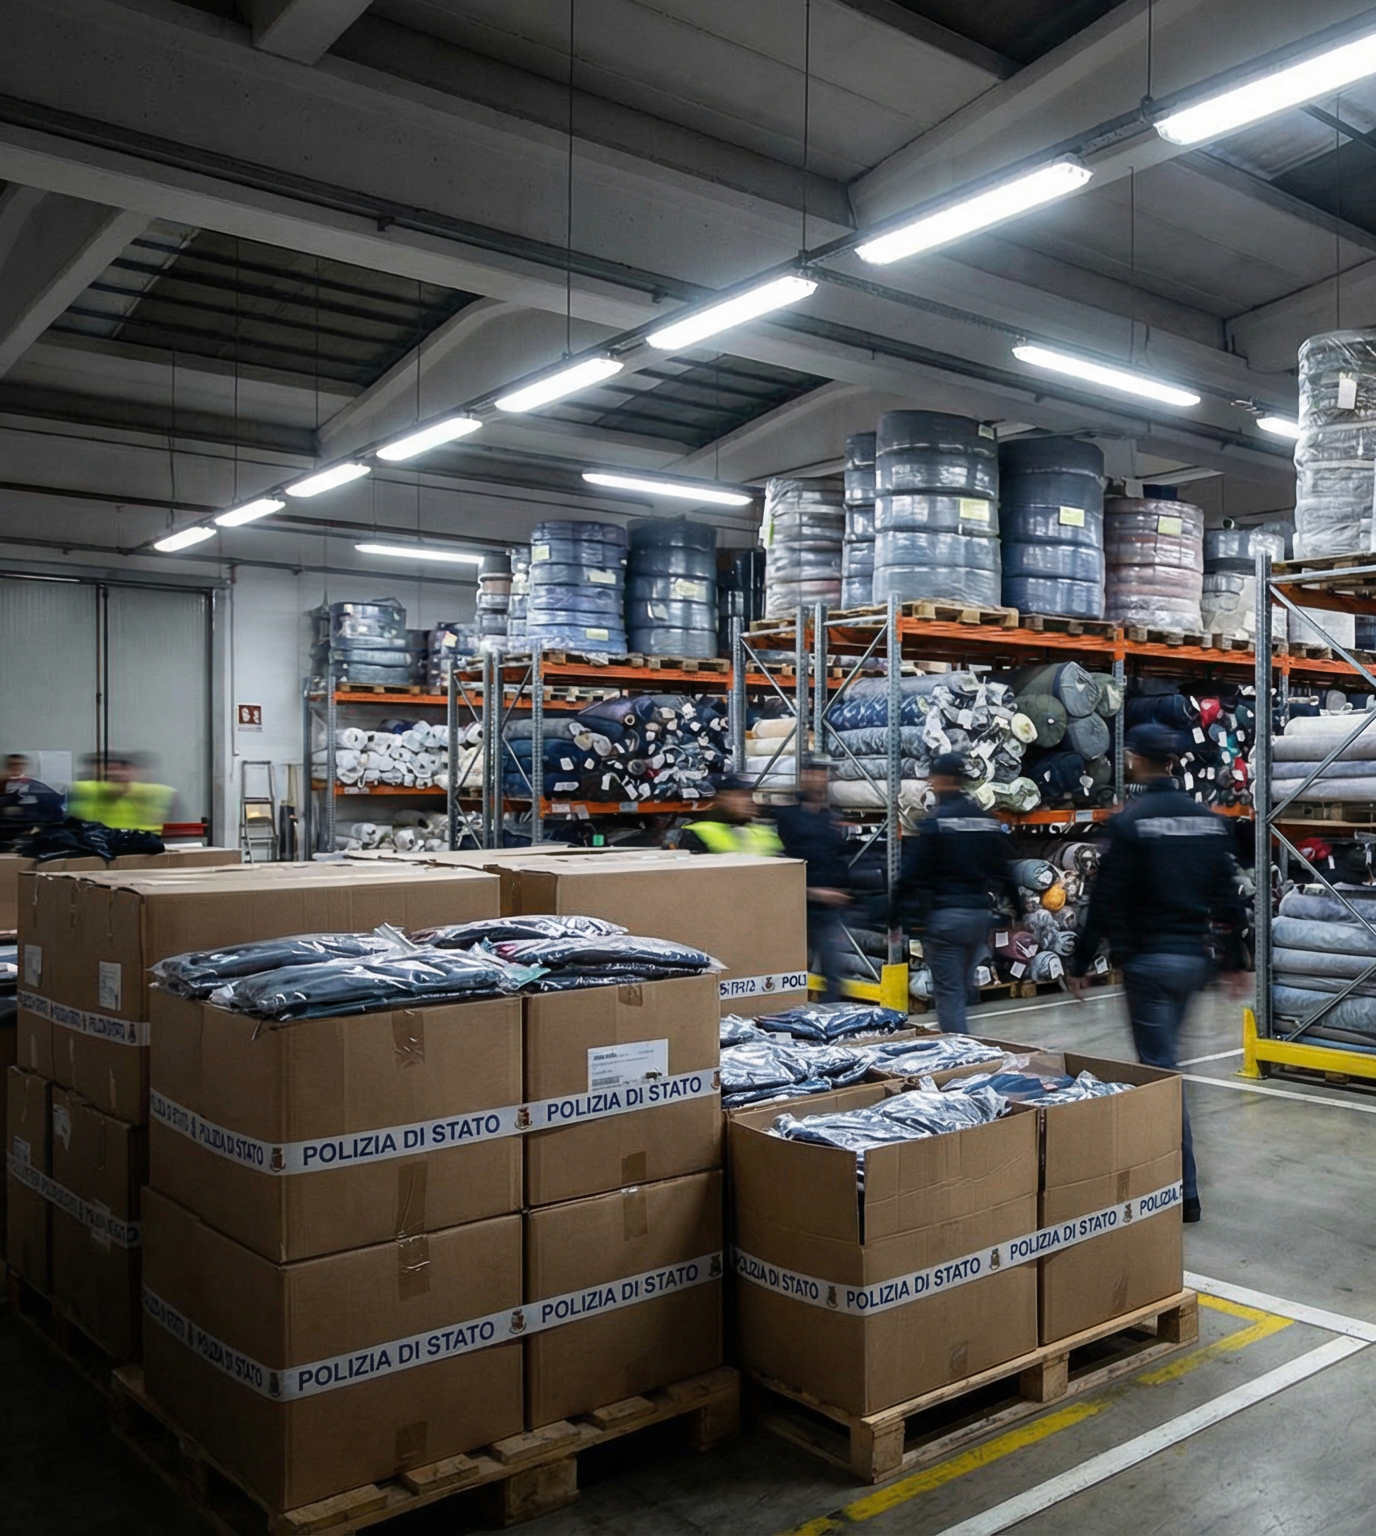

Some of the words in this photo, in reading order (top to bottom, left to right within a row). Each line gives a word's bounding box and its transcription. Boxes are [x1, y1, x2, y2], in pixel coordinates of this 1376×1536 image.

[547, 1091, 622, 1122] POLIZIA
[626, 1087, 644, 1107] DI
[648, 1076, 702, 1102] STATO
[302, 1133, 397, 1166] POLIZIA
[403, 1127, 425, 1149] DI
[432, 1114, 501, 1144] STATO
[1010, 1229, 1061, 1261] POLIZIA
[1063, 1223, 1076, 1242] DI
[1079, 1210, 1117, 1236] STATO
[541, 1287, 618, 1323] POLIZIA
[621, 1280, 639, 1301] DI
[643, 1263, 699, 1294] STATO
[737, 1254, 768, 1284] OLIZIA
[768, 1268, 780, 1288] DI
[782, 1273, 819, 1300] STATO
[846, 1280, 910, 1310] POLIZIA
[914, 1273, 930, 1294] DI
[933, 1257, 981, 1288] STATO
[298, 1349, 392, 1392] POLIZIA
[398, 1341, 420, 1365] DI
[426, 1320, 495, 1356] STATO
